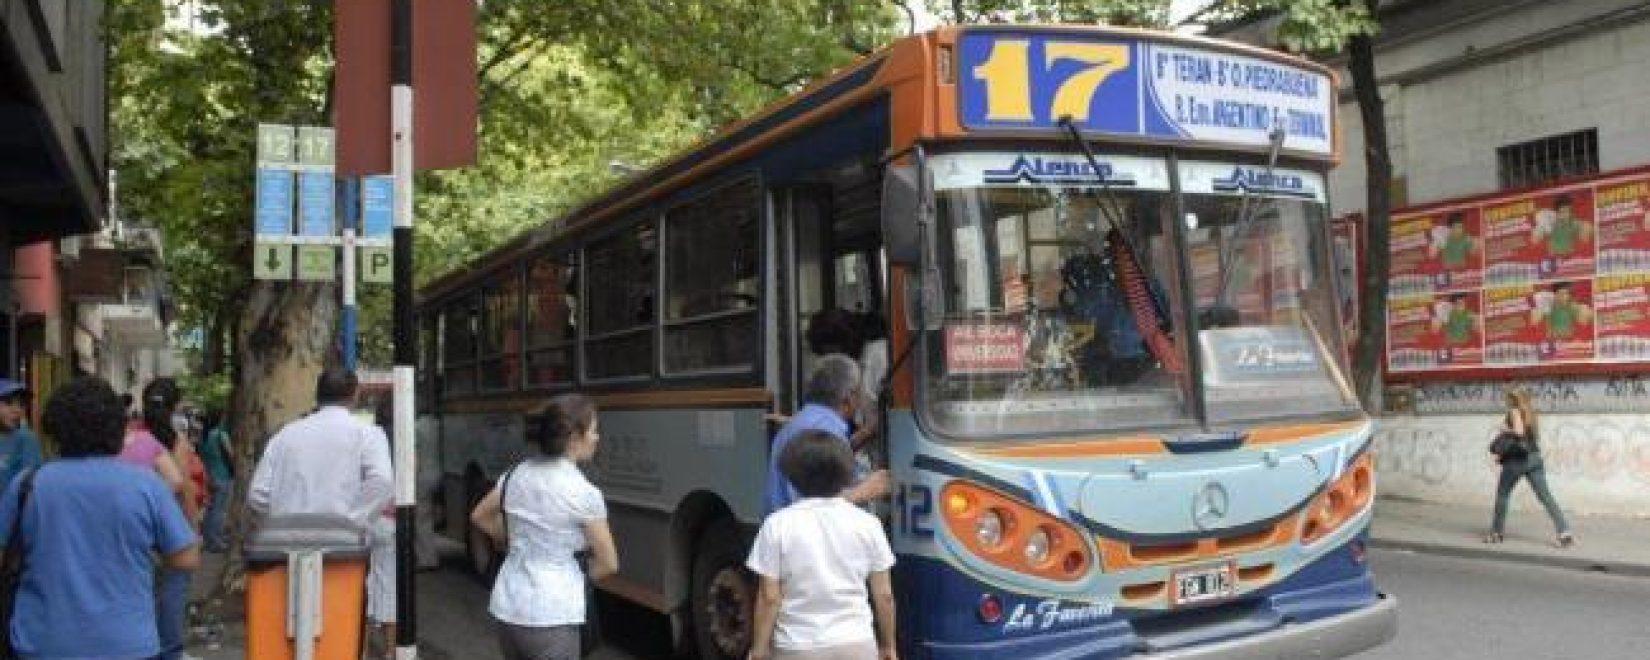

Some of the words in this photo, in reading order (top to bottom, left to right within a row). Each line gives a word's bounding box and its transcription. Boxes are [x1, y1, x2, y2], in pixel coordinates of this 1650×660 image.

[973, 39, 1131, 122] 17
[262, 133, 290, 158] 12
[305, 136, 329, 156] 17
[372, 253, 389, 275] P
[895, 484, 934, 537] 12
[1003, 603, 1034, 634] La
